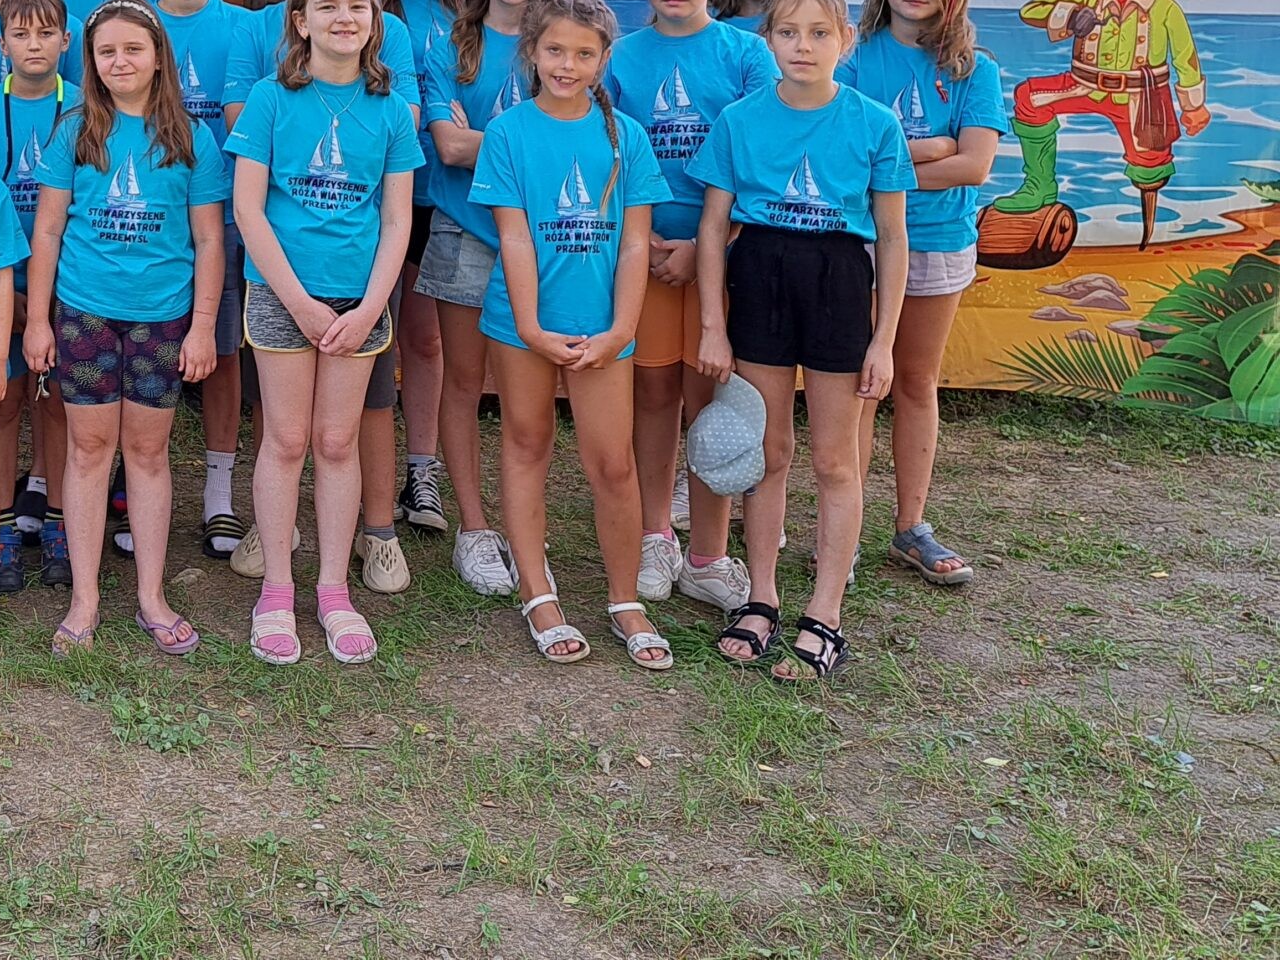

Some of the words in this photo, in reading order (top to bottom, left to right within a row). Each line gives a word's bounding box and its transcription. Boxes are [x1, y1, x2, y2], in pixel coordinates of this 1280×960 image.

[287, 177, 369, 193] STOWARZYSZENIE
[291, 188, 317, 199] RÓŻA
[320, 190, 362, 203] WIATRÓW
[91, 218, 116, 230] RÓŻA
[119, 220, 162, 232] WIATRÓW
[769, 212, 797, 225] RÓŻA
[99, 231, 149, 244] PRZEMYŚL
[545, 231, 570, 242] RÓŻA
[574, 231, 610, 243] WIATRÓW
[555, 242, 601, 254] PRZEMYŚL
